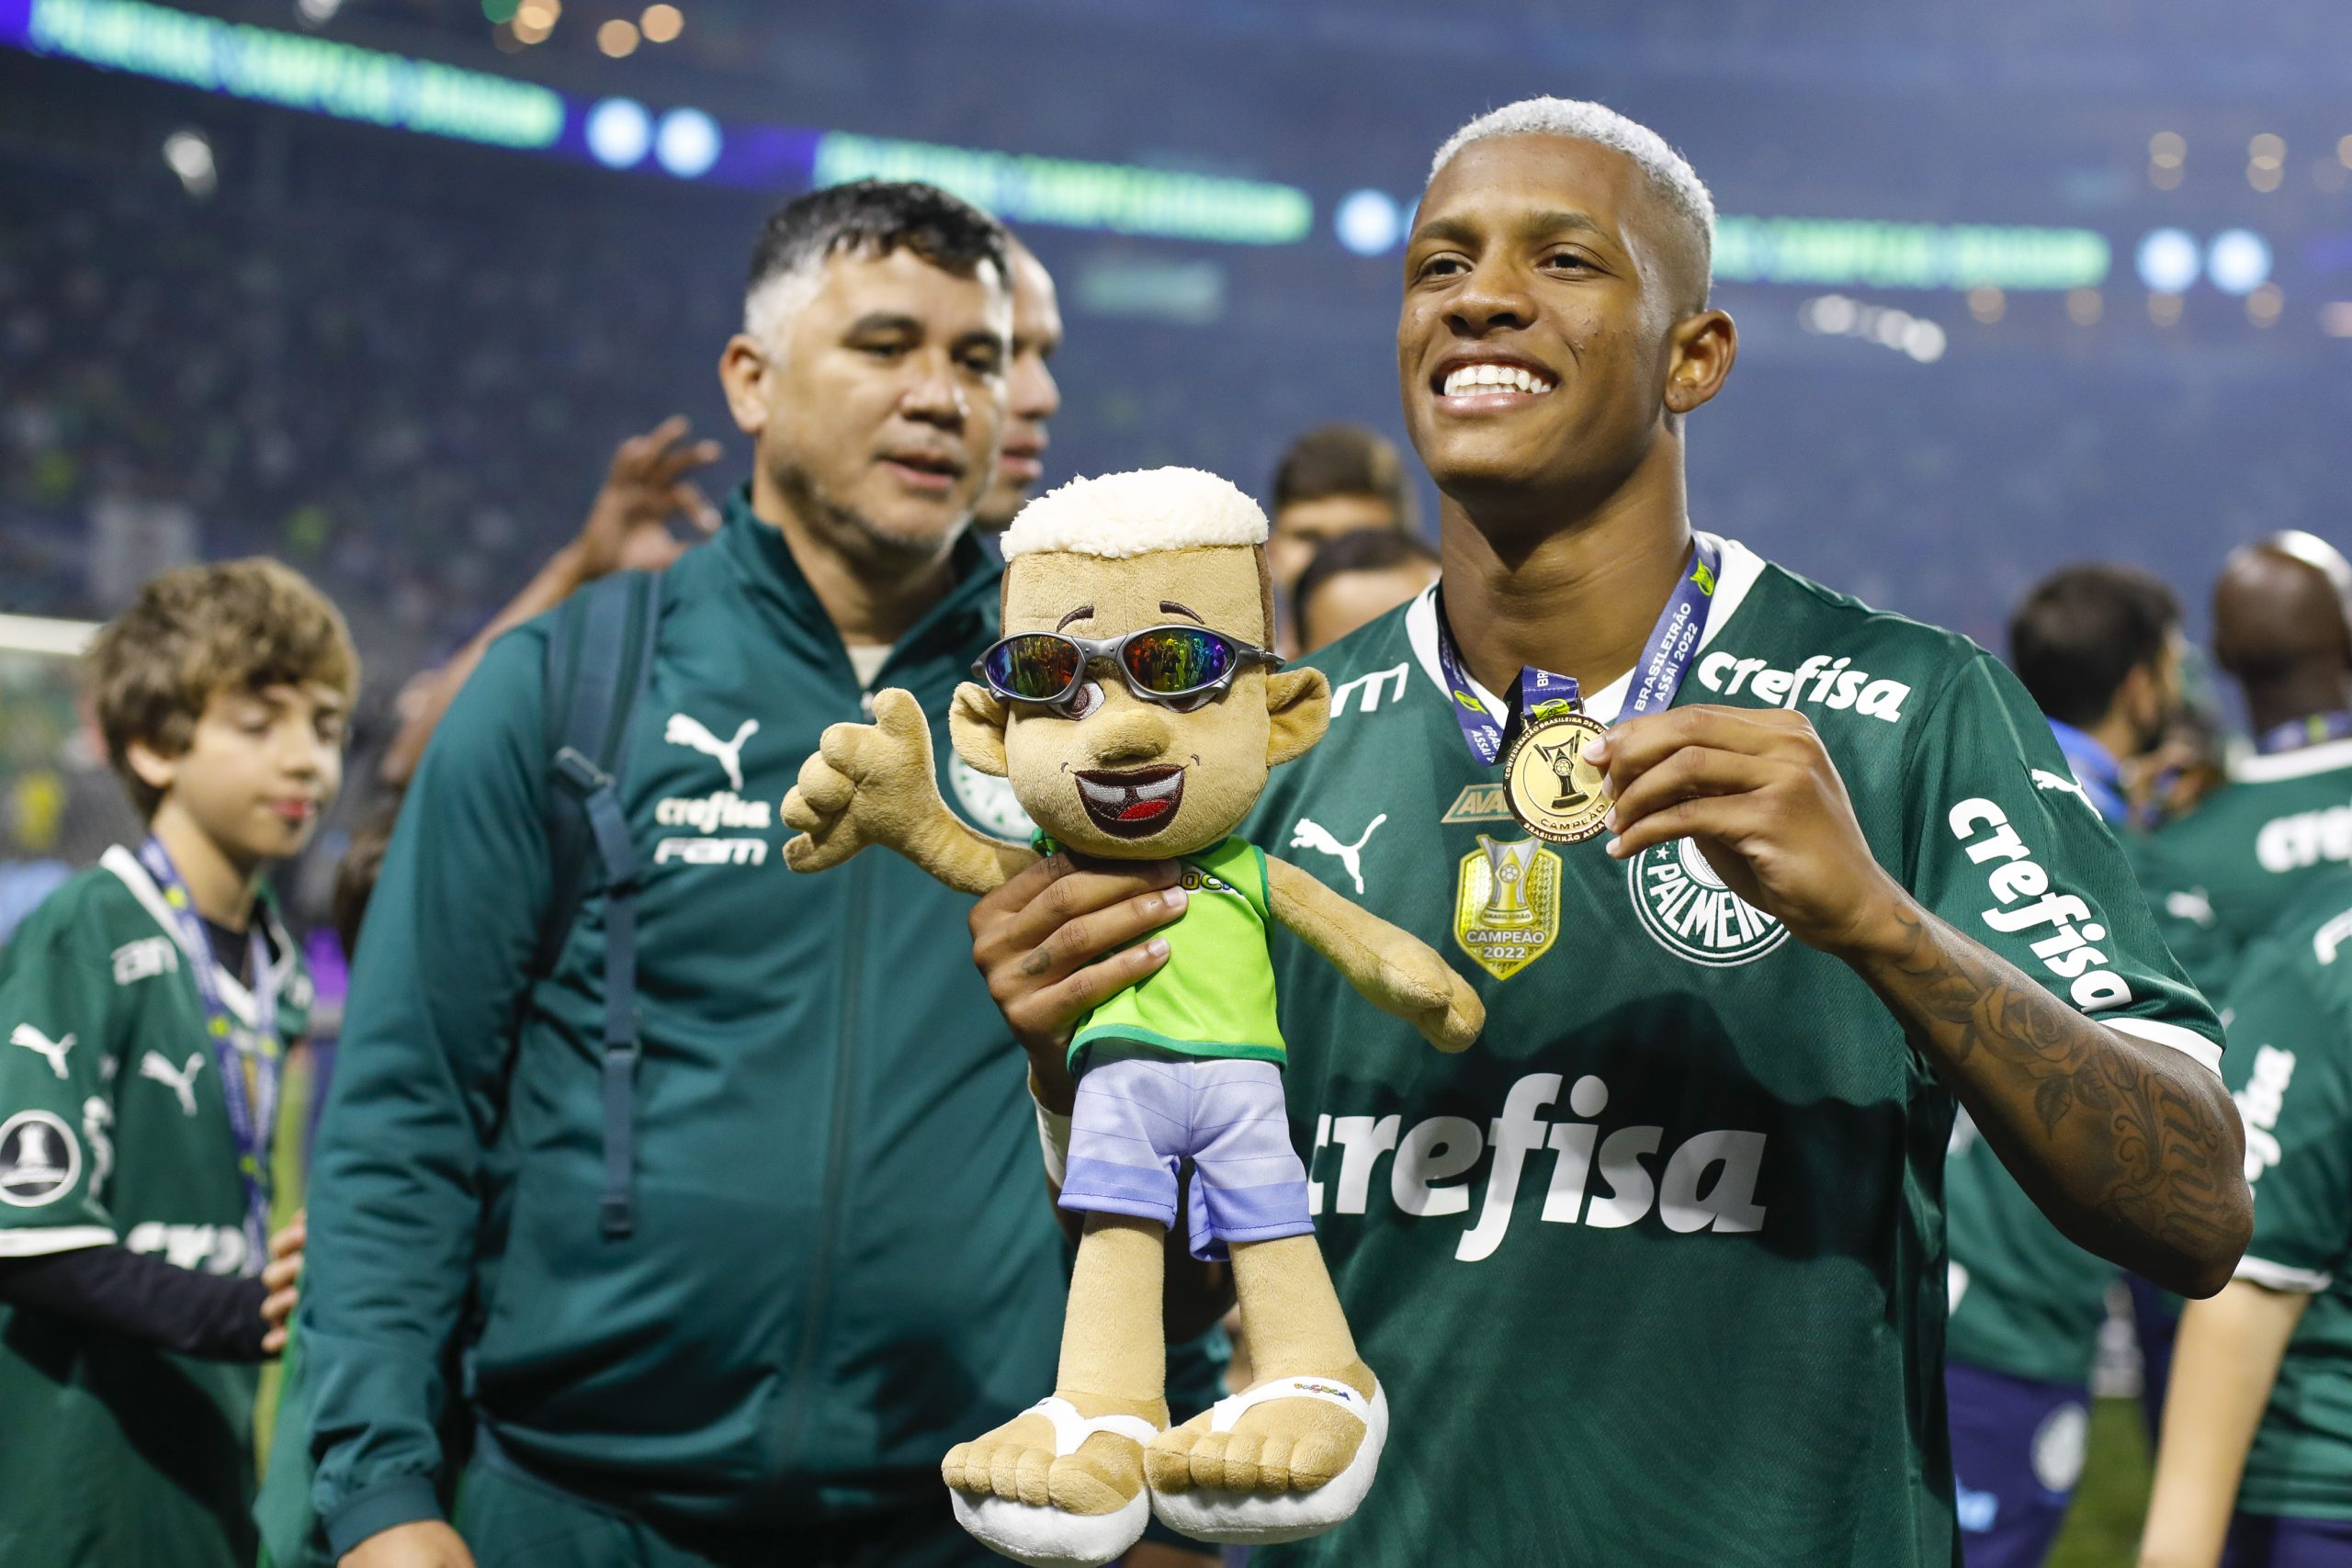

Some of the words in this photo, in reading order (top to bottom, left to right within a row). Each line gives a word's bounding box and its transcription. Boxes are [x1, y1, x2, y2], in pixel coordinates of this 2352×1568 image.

[1634, 603, 1691, 712] BRASILEIRÃO
[1654, 660, 1679, 702] ASSAÍ
[1674, 622, 1699, 661] 2022
[1697, 650, 1912, 724] crefisa
[1540, 803, 1606, 830] CAMPEÃO
[1465, 929, 1545, 943] CAMPEÃO
[1949, 797, 2132, 1014] crefisa
[1483, 946, 1526, 958] 2022
